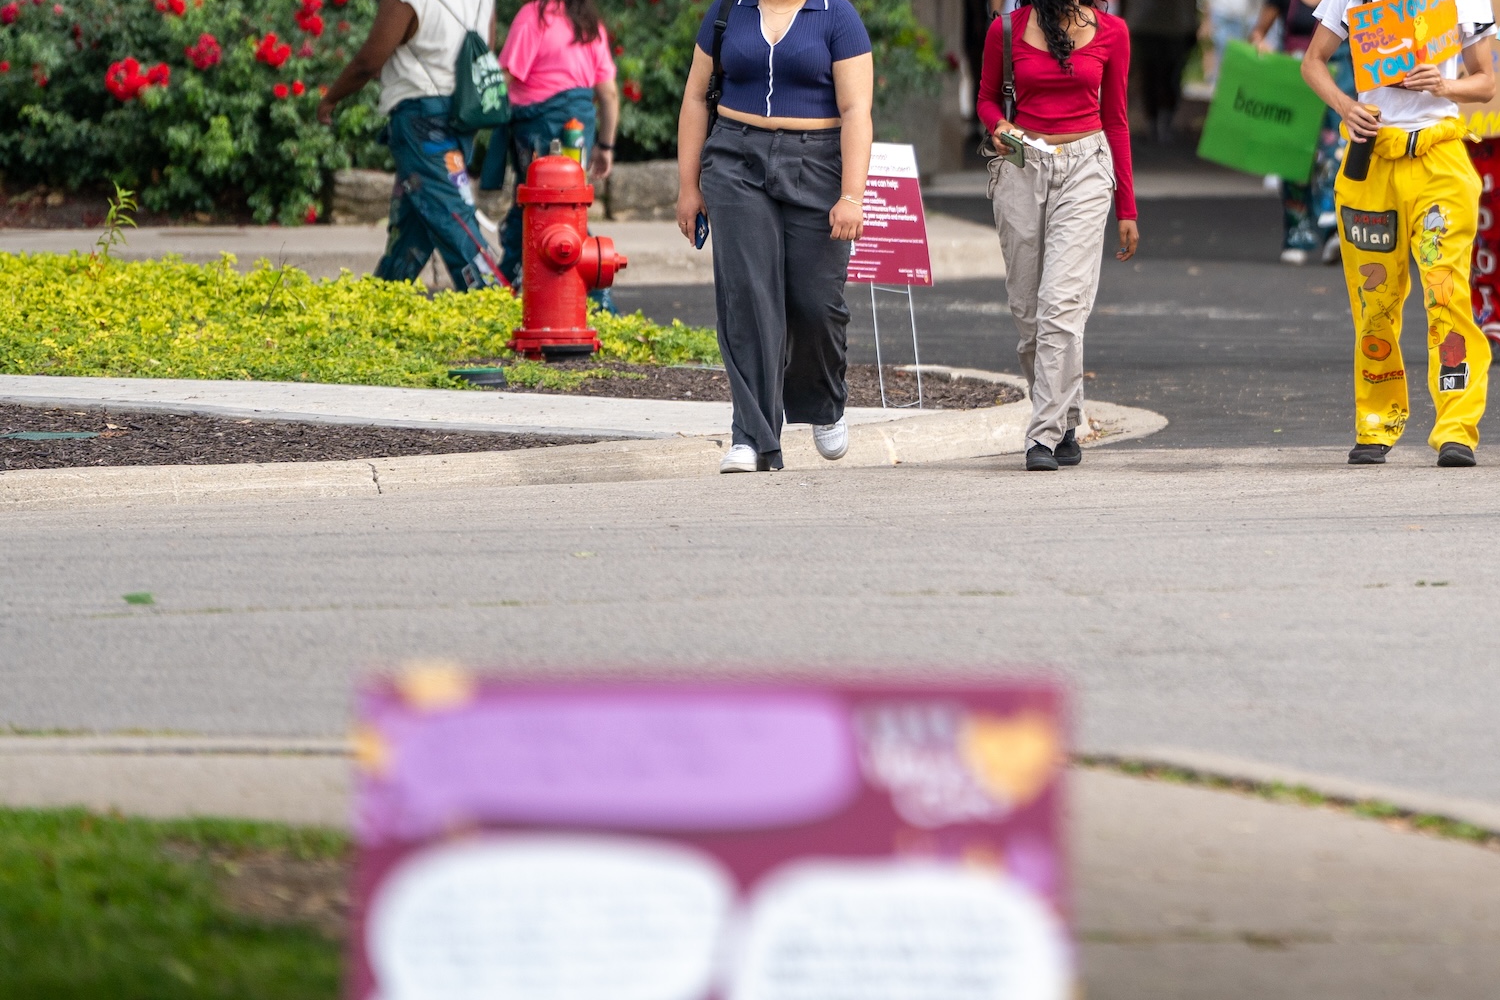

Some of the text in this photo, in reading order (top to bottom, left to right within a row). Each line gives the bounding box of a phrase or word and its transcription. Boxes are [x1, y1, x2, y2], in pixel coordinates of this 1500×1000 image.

[1353, 5, 1384, 31] IF
[1353, 27, 1384, 44] The
[1362, 51, 1416, 85] YOU
[1351, 225, 1390, 245] Alan
[1362, 369, 1404, 381] COSTCO
[1443, 376, 1456, 390] N
